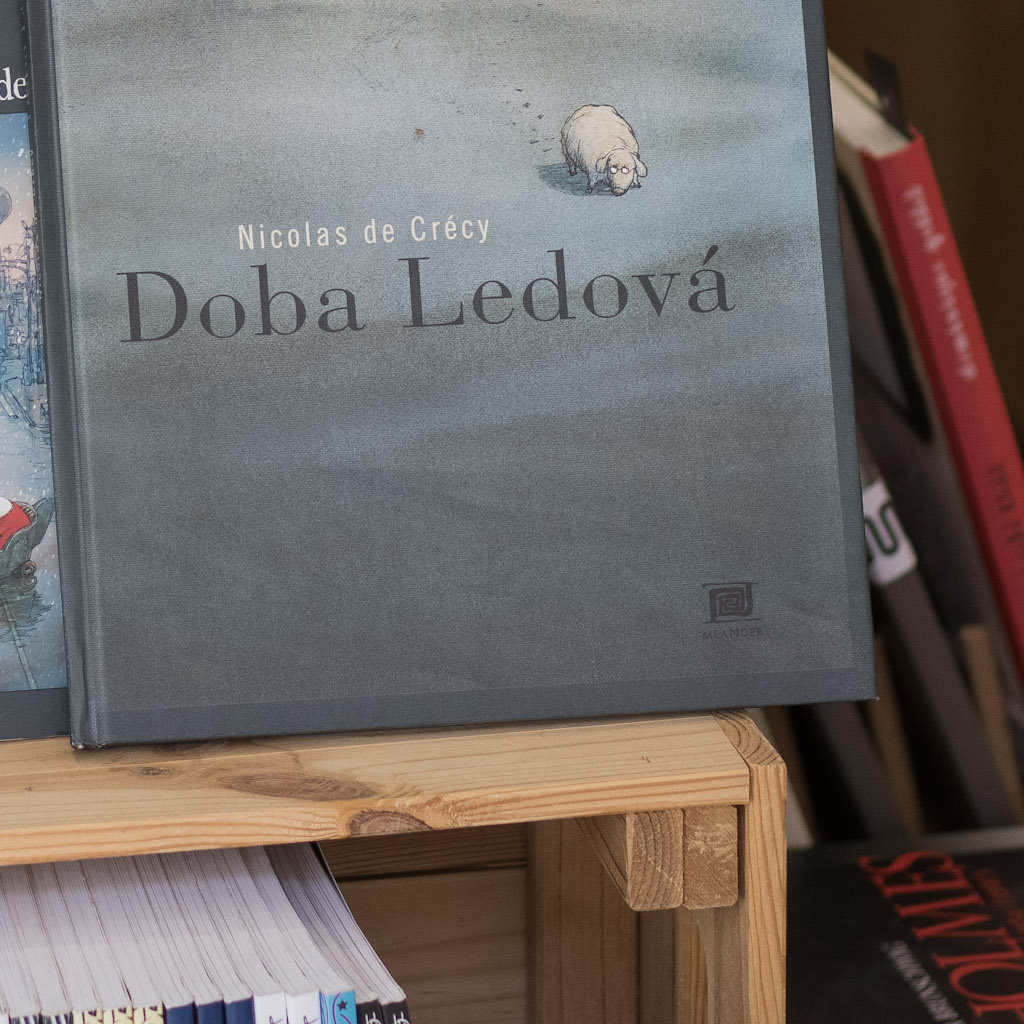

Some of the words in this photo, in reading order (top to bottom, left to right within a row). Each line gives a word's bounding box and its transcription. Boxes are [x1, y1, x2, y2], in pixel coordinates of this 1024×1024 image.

[238, 223, 348, 251] Nicolas
[363, 218, 396, 245] de
[410, 215, 491, 245] Crécy
[116, 262, 367, 343] Doba
[398, 244, 737, 329] Ledová
[702, 627, 763, 640] MEANDER
